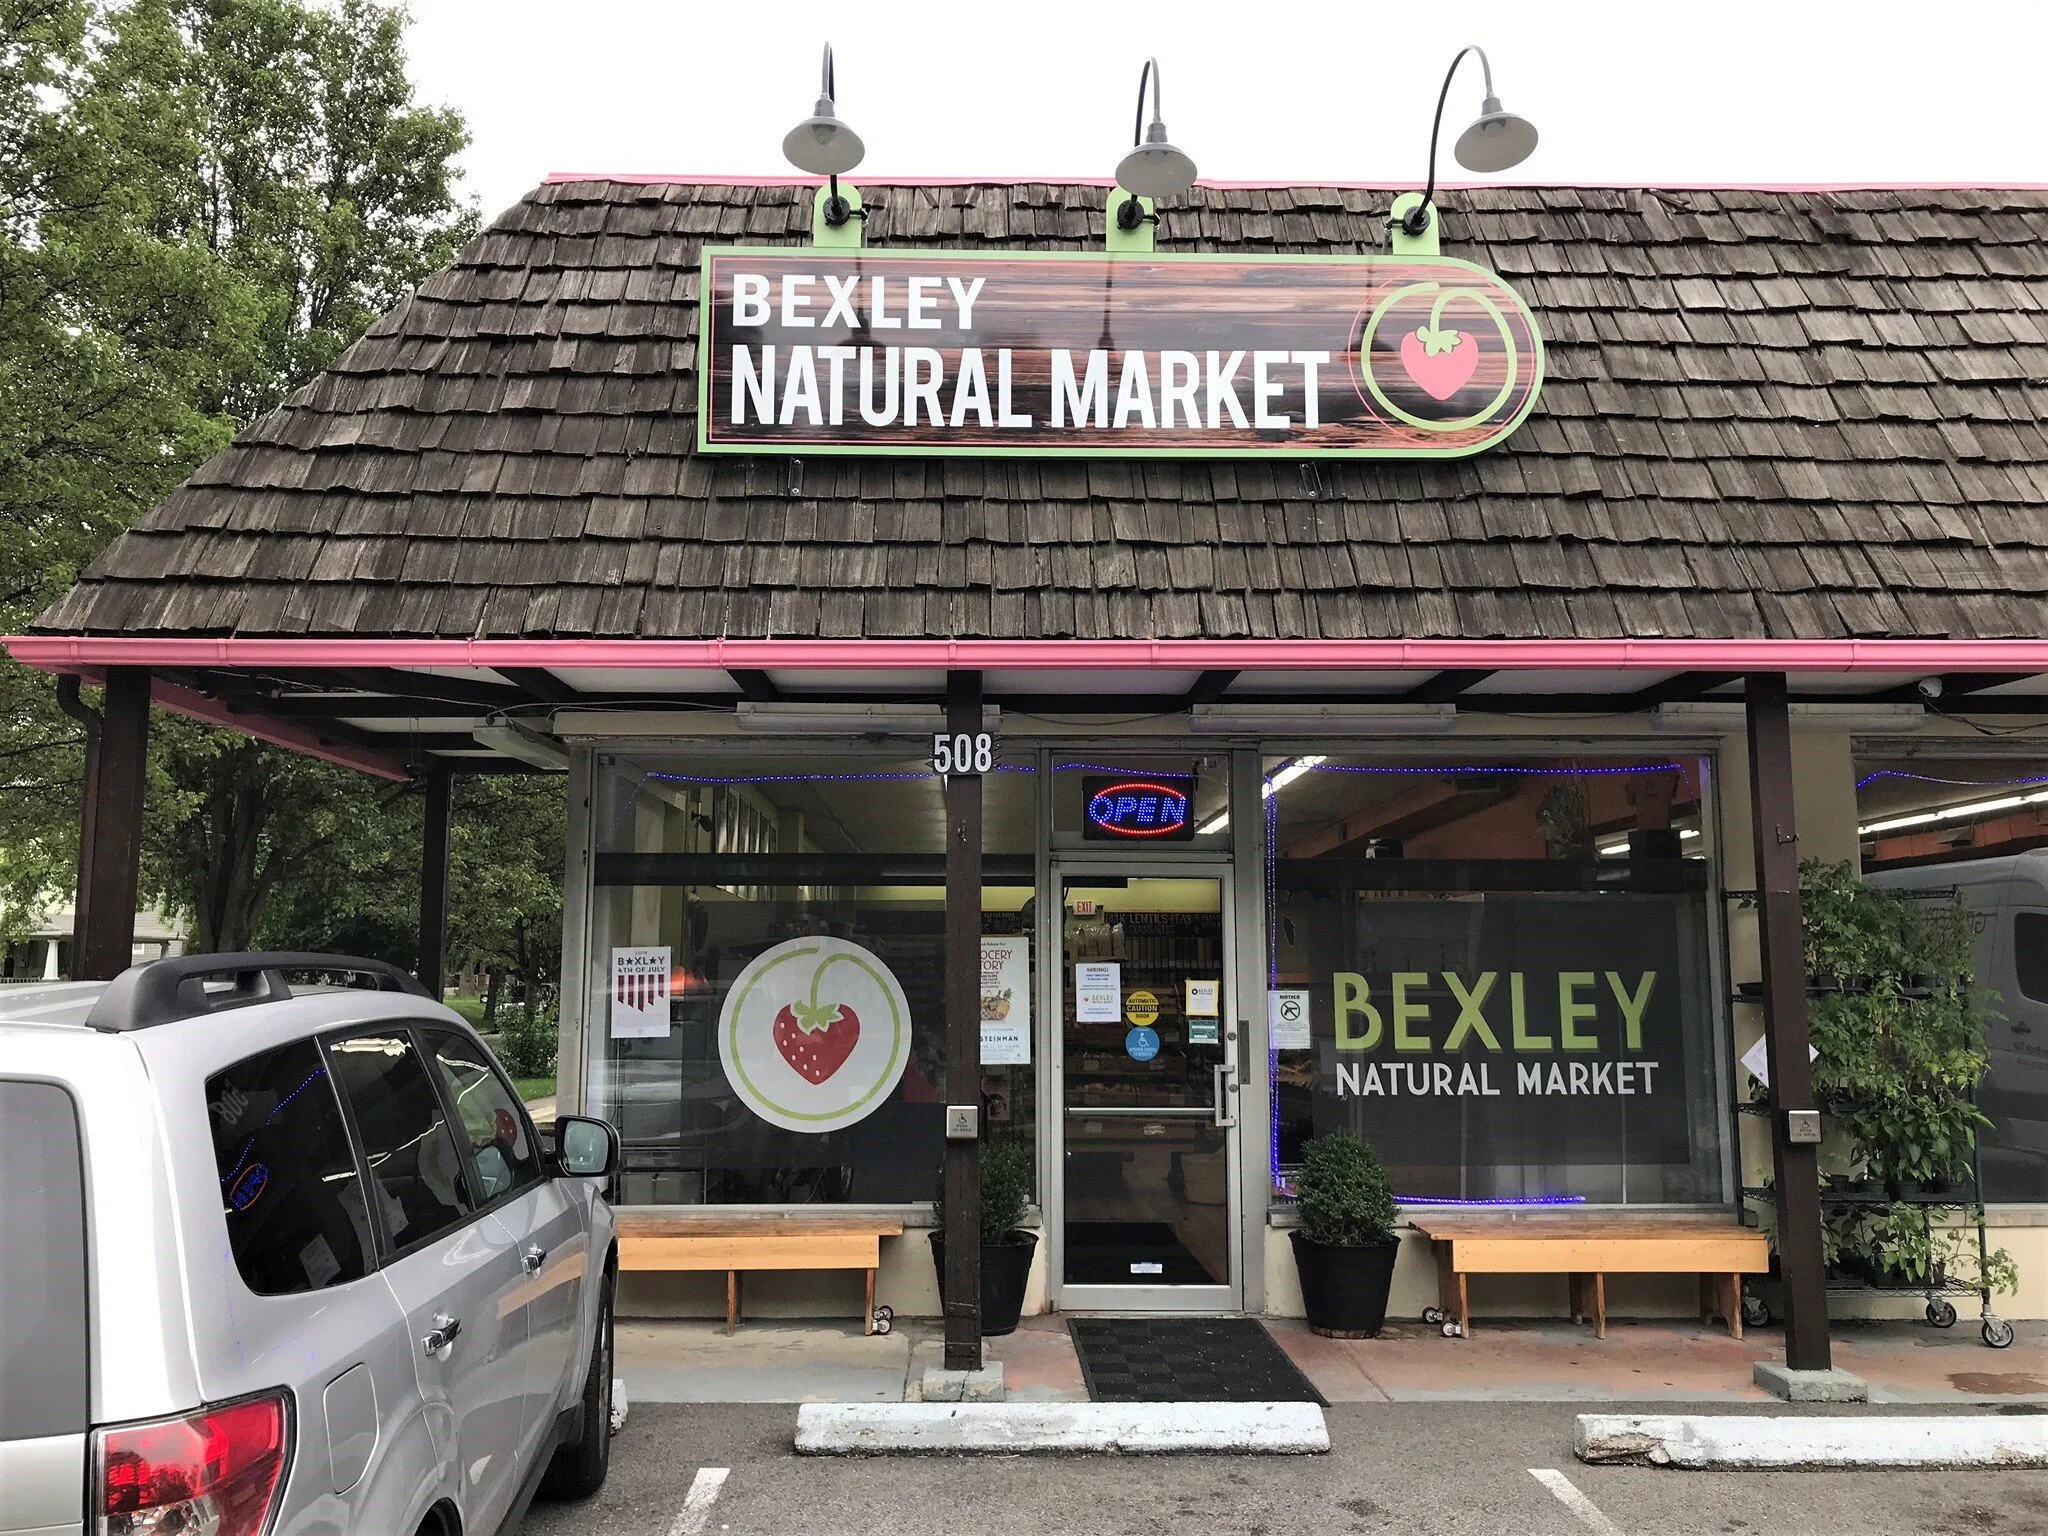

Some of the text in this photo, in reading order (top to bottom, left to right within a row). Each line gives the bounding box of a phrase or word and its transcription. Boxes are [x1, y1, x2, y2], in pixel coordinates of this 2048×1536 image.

[733, 273, 986, 330] BEXLEY
[731, 344, 1331, 430] NATURAL MARKET
[933, 733, 993, 773] 508
[1089, 796, 1187, 823] OPEN
[1077, 901, 1093, 913] EXIT
[1126, 1004, 1158, 1012] CAUTION
[1333, 970, 1657, 1052] BEXLEY
[1335, 1061, 1659, 1097] NATURAL MARKET
